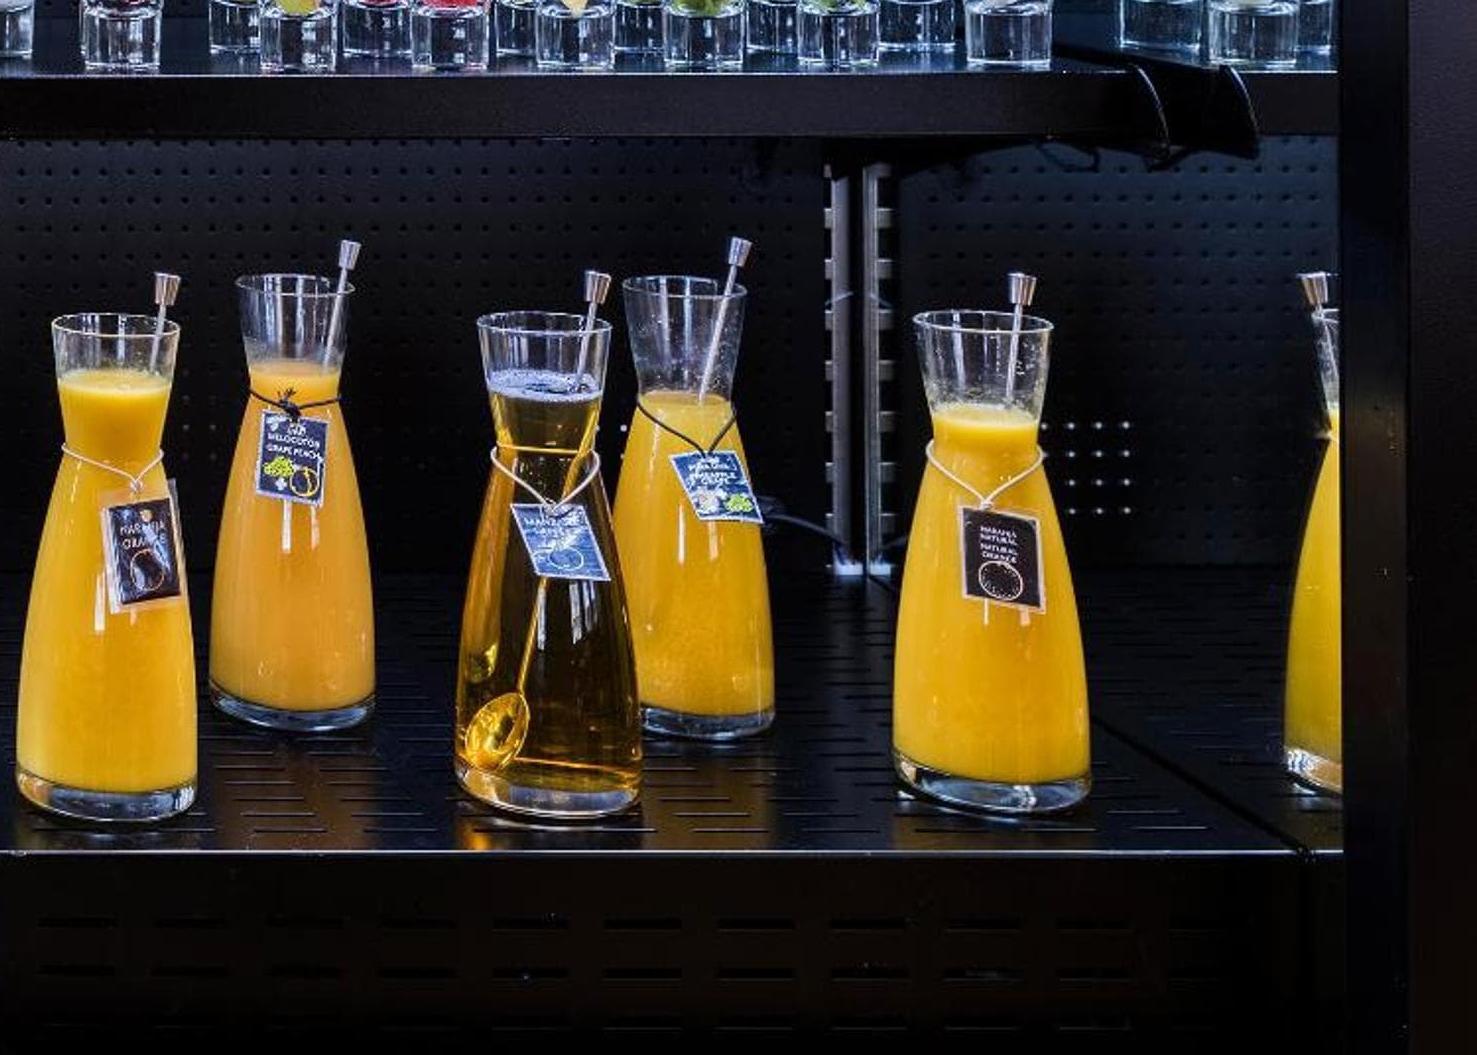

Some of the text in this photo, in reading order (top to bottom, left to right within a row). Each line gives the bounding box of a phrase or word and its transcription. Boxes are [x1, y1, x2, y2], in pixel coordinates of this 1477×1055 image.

[980, 533, 1019, 547] NATURAL
[980, 543, 1020, 556] NATURAL
[981, 551, 1018, 564] ORANGE
